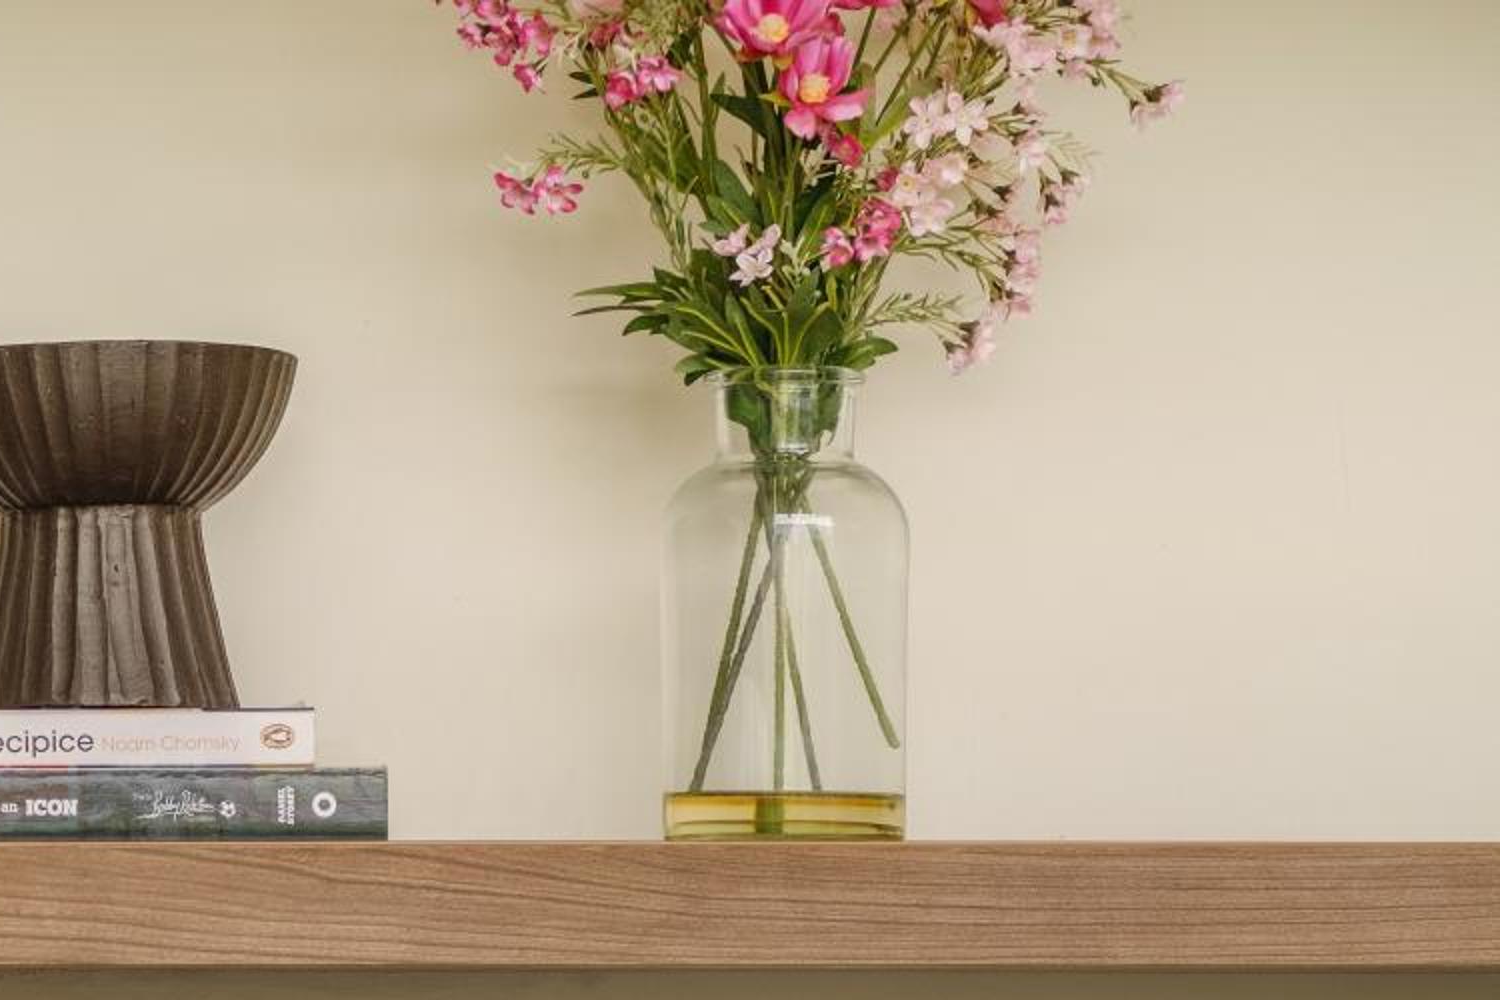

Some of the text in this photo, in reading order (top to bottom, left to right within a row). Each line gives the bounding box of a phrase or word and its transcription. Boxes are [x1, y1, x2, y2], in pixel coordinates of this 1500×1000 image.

[101, 736, 156, 752] Noam
[162, 735, 240, 754] Chomsky
[1, 802, 18, 813] an
[25, 799, 78, 816] ICON
